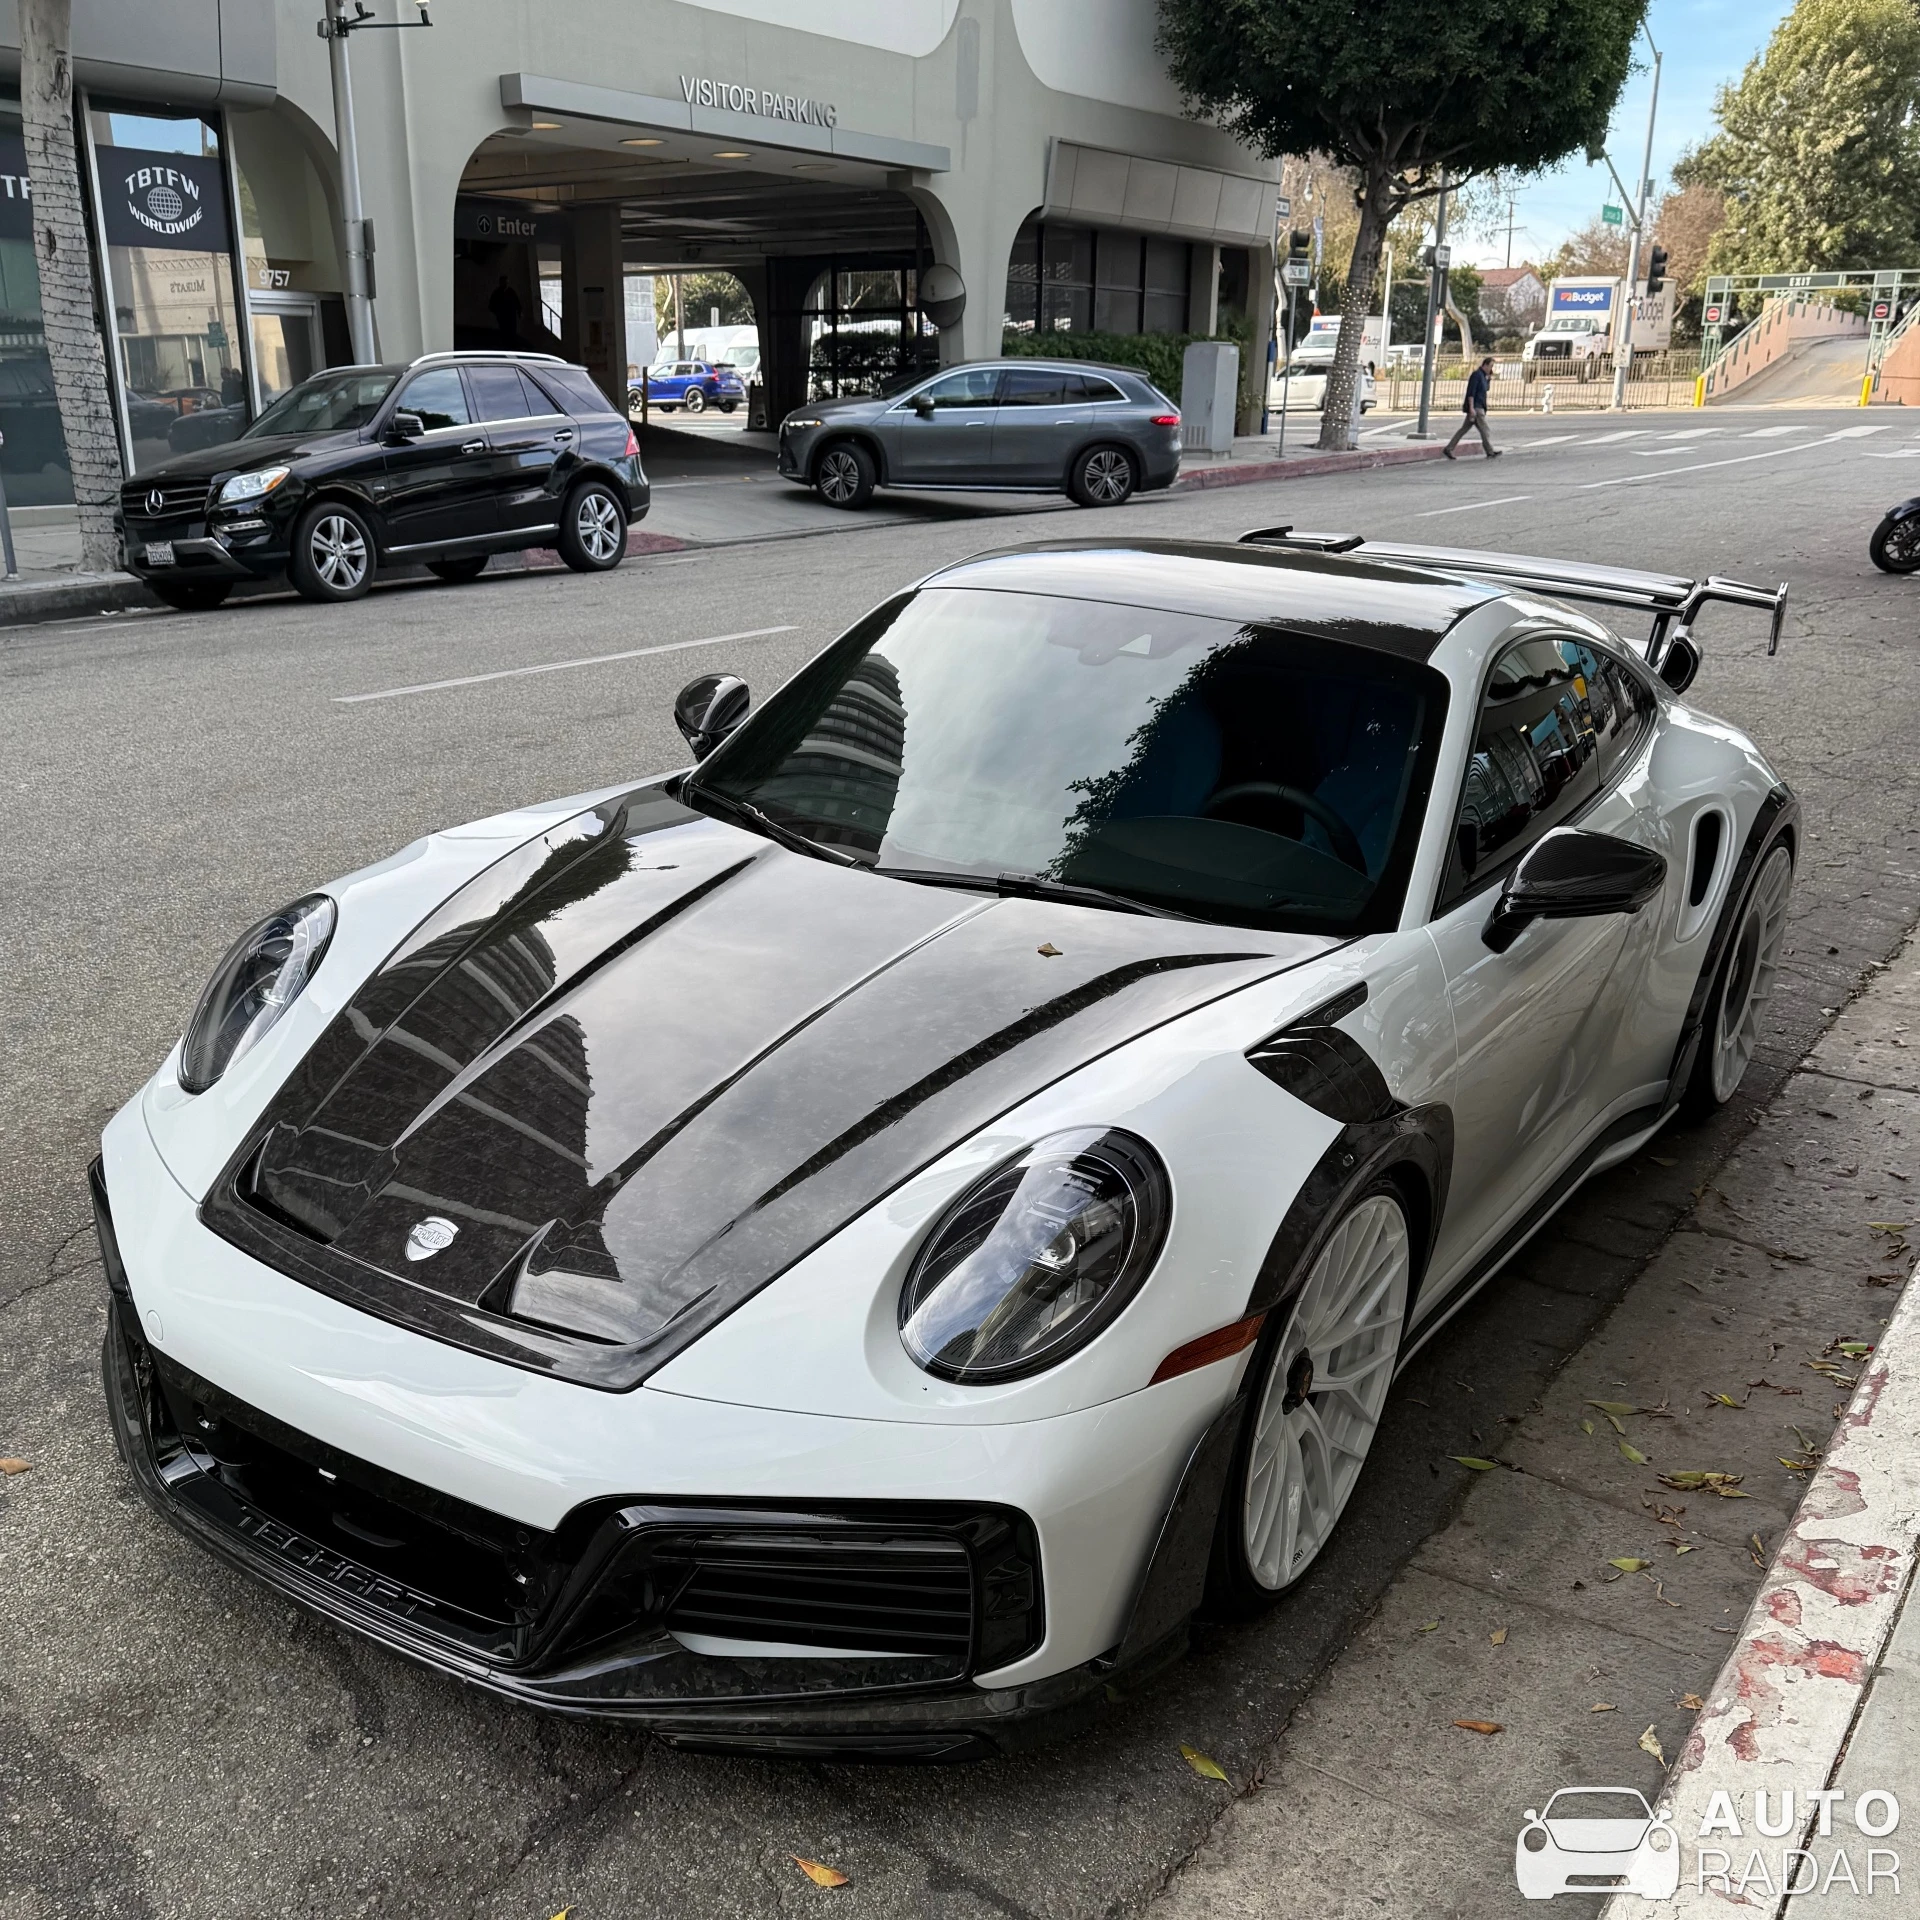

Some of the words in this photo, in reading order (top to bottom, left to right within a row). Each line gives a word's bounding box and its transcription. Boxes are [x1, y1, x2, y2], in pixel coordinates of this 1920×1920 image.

[679, 75, 758, 114] VISITOR
[761, 91, 838, 128] PARKING
[125, 166, 200, 200] TBTFW
[128, 200, 203, 235] WORLDWIDE
[497, 216, 537, 236] Enter
[259, 269, 290, 287] 9757
[1789, 276, 1812, 287] EXIT
[1572, 292, 1604, 304] Budget
[238, 1506, 437, 1616] TECHART
